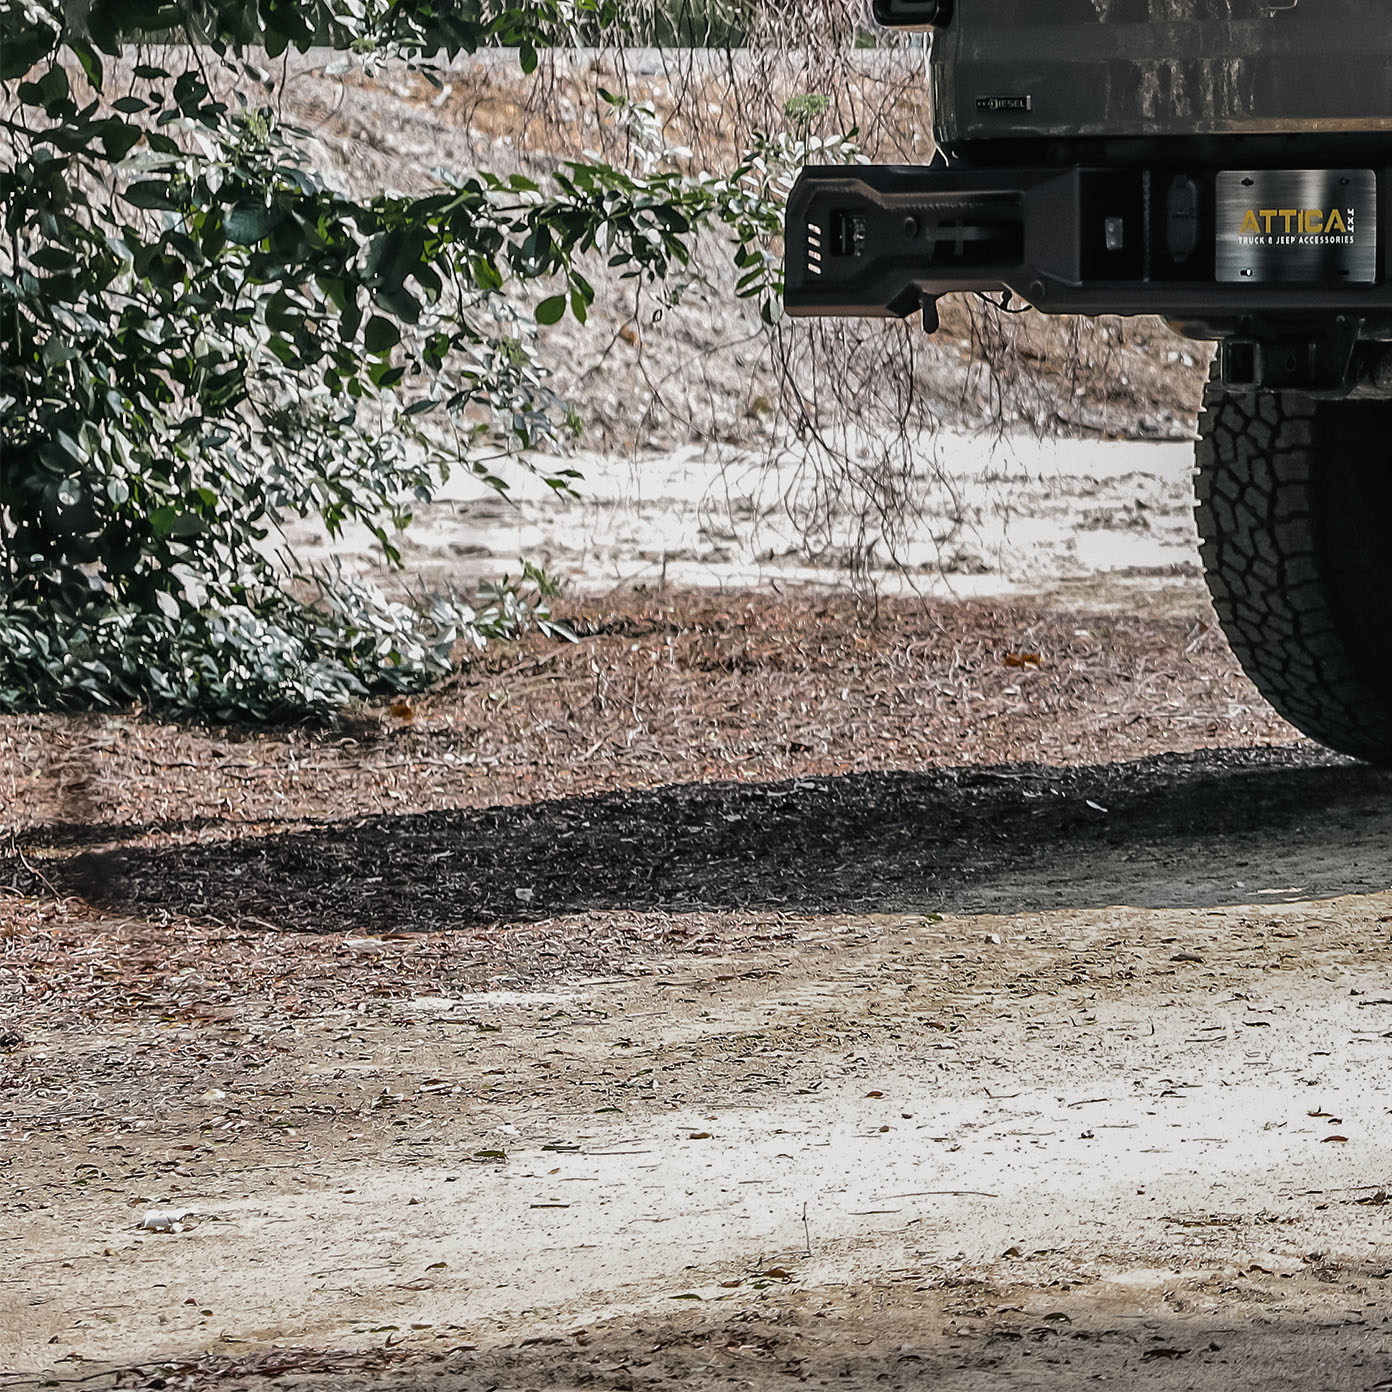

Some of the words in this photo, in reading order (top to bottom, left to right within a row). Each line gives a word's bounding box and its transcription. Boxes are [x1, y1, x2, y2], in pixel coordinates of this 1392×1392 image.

[1240, 209, 1347, 233] ATTICA
[1239, 236, 1265, 245] TRUCK
[1276, 236, 1295, 245] JEEP
[1299, 235, 1355, 245] ACCESSORIES
